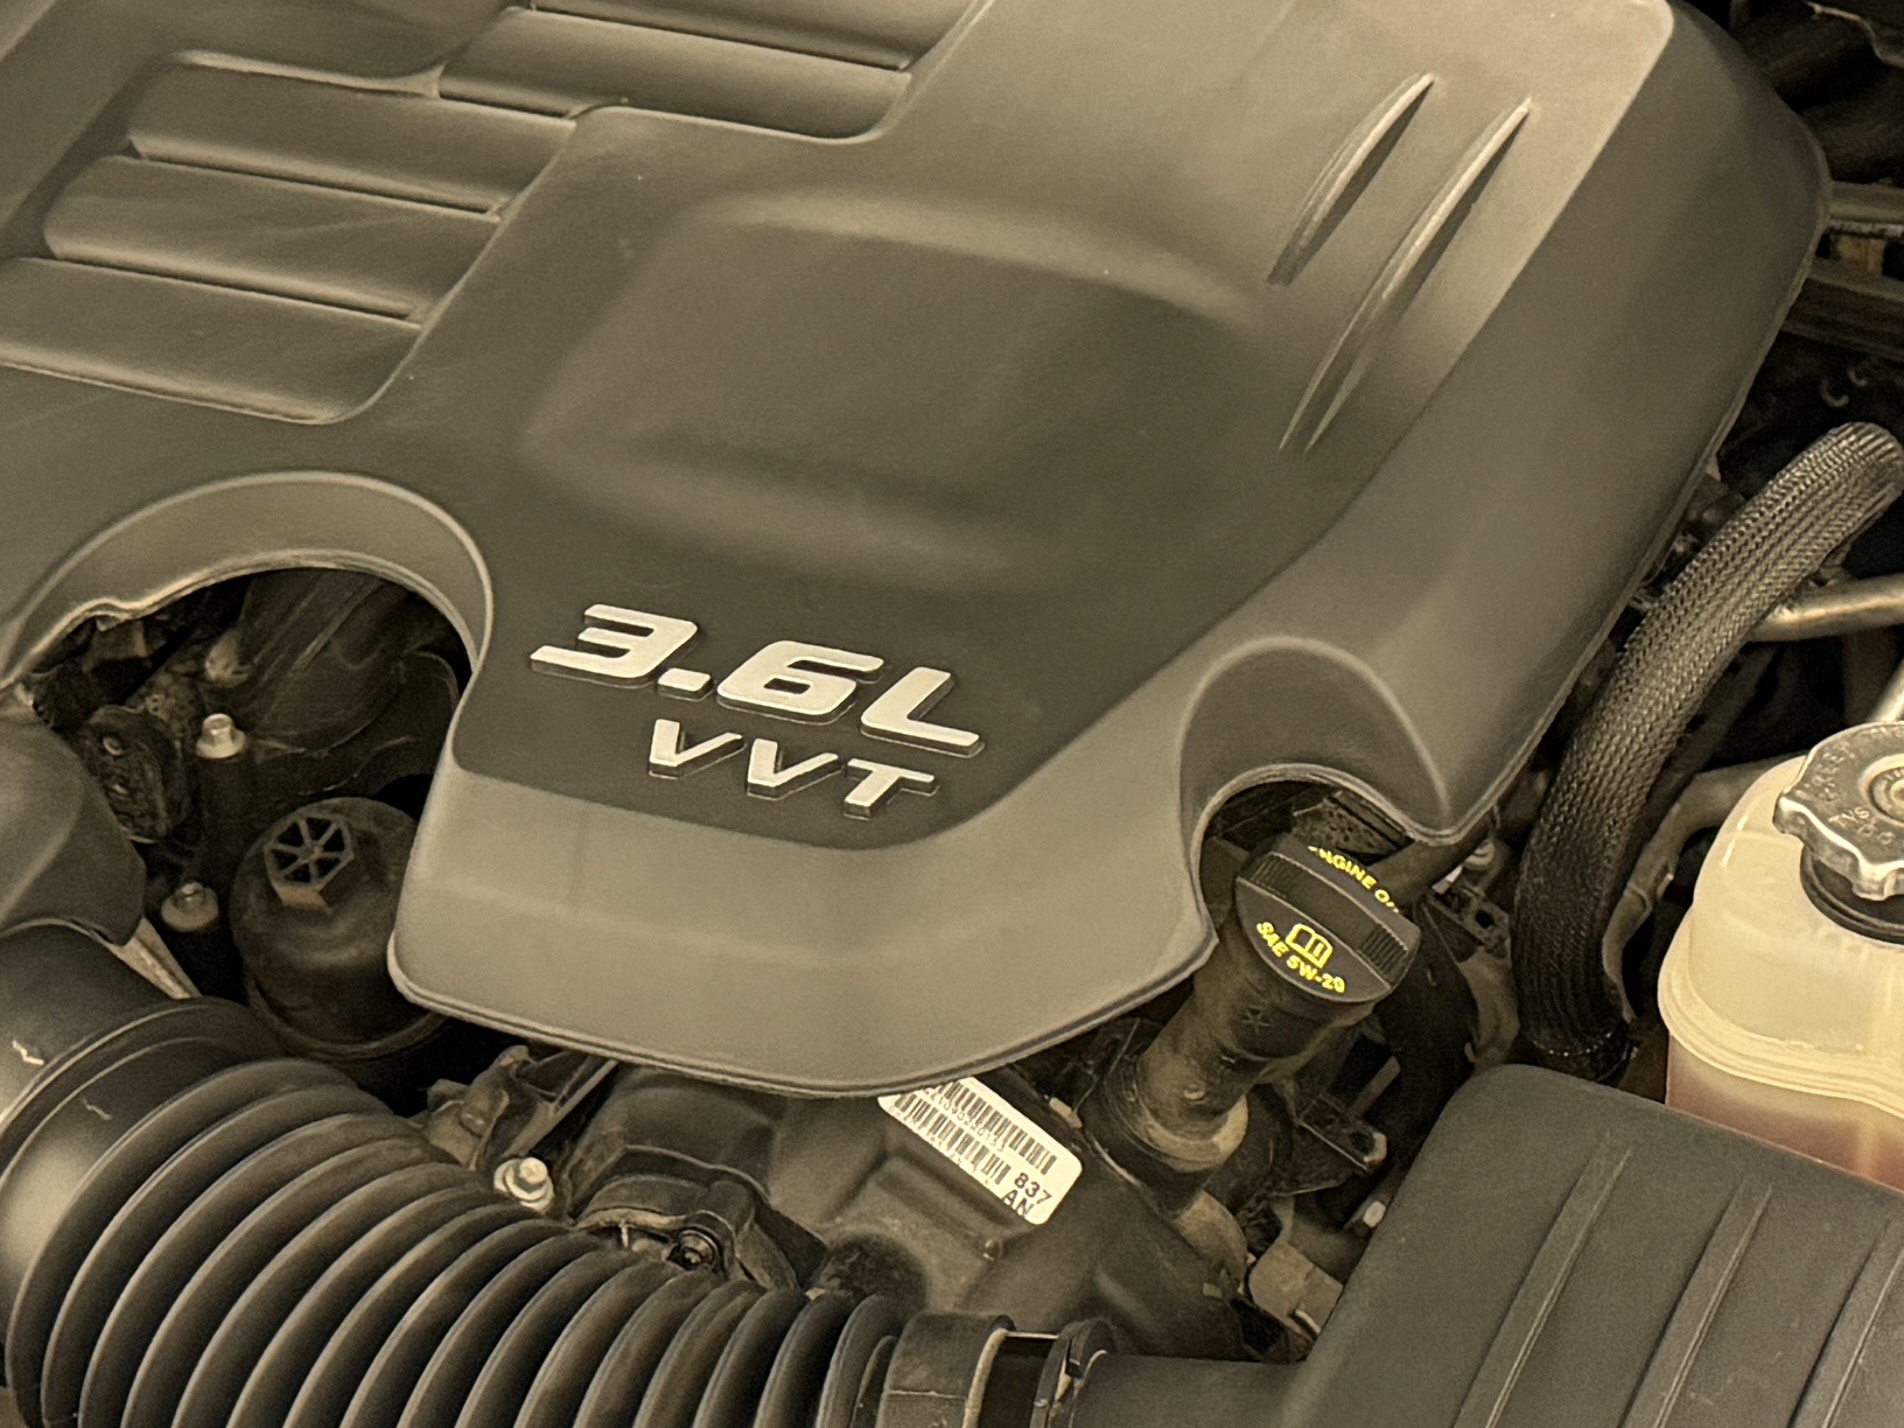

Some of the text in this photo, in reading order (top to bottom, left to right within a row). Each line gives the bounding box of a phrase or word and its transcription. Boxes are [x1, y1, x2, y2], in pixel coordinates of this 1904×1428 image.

[530, 604, 984, 754] 3.6L
[649, 719, 937, 818] VVT
[1256, 922, 1346, 993] SAE 5W-20
[1001, 1189, 1035, 1218] AN
[1014, 1172, 1052, 1205] 837
